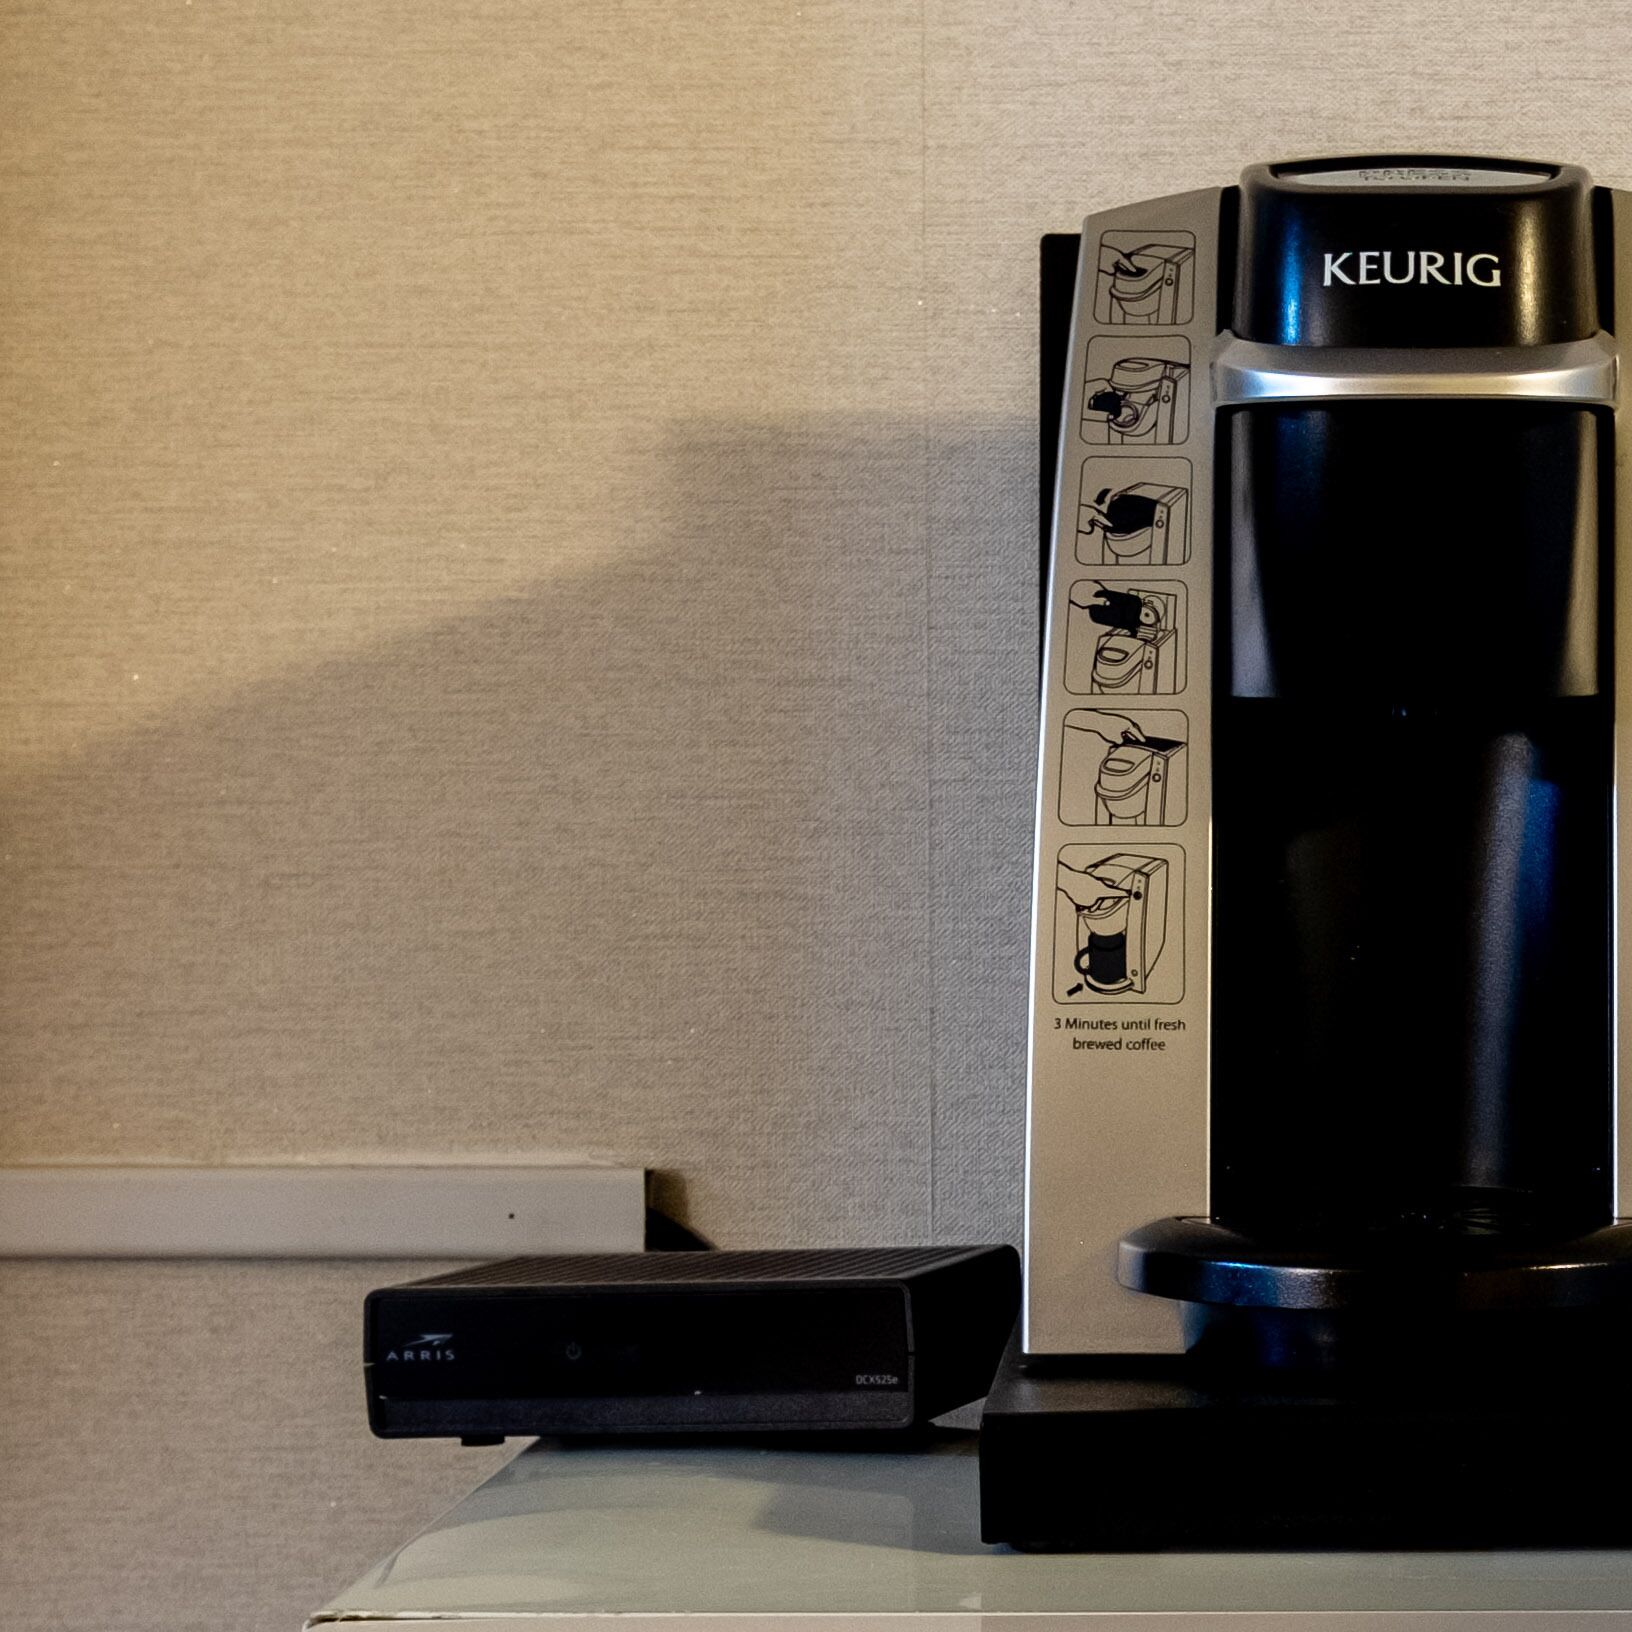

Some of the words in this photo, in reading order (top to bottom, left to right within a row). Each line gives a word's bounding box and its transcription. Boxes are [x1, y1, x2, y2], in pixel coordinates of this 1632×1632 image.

[1322, 250, 1501, 287] KEURIG
[1053, 1017, 1062, 1030] 3
[1064, 1017, 1119, 1031] Minutes
[1121, 1017, 1151, 1031] until
[1154, 1018, 1186, 1031] fresh
[1072, 1036, 1123, 1051] brewed
[1125, 1037, 1166, 1051] coffee
[386, 1349, 456, 1361] ARRIS
